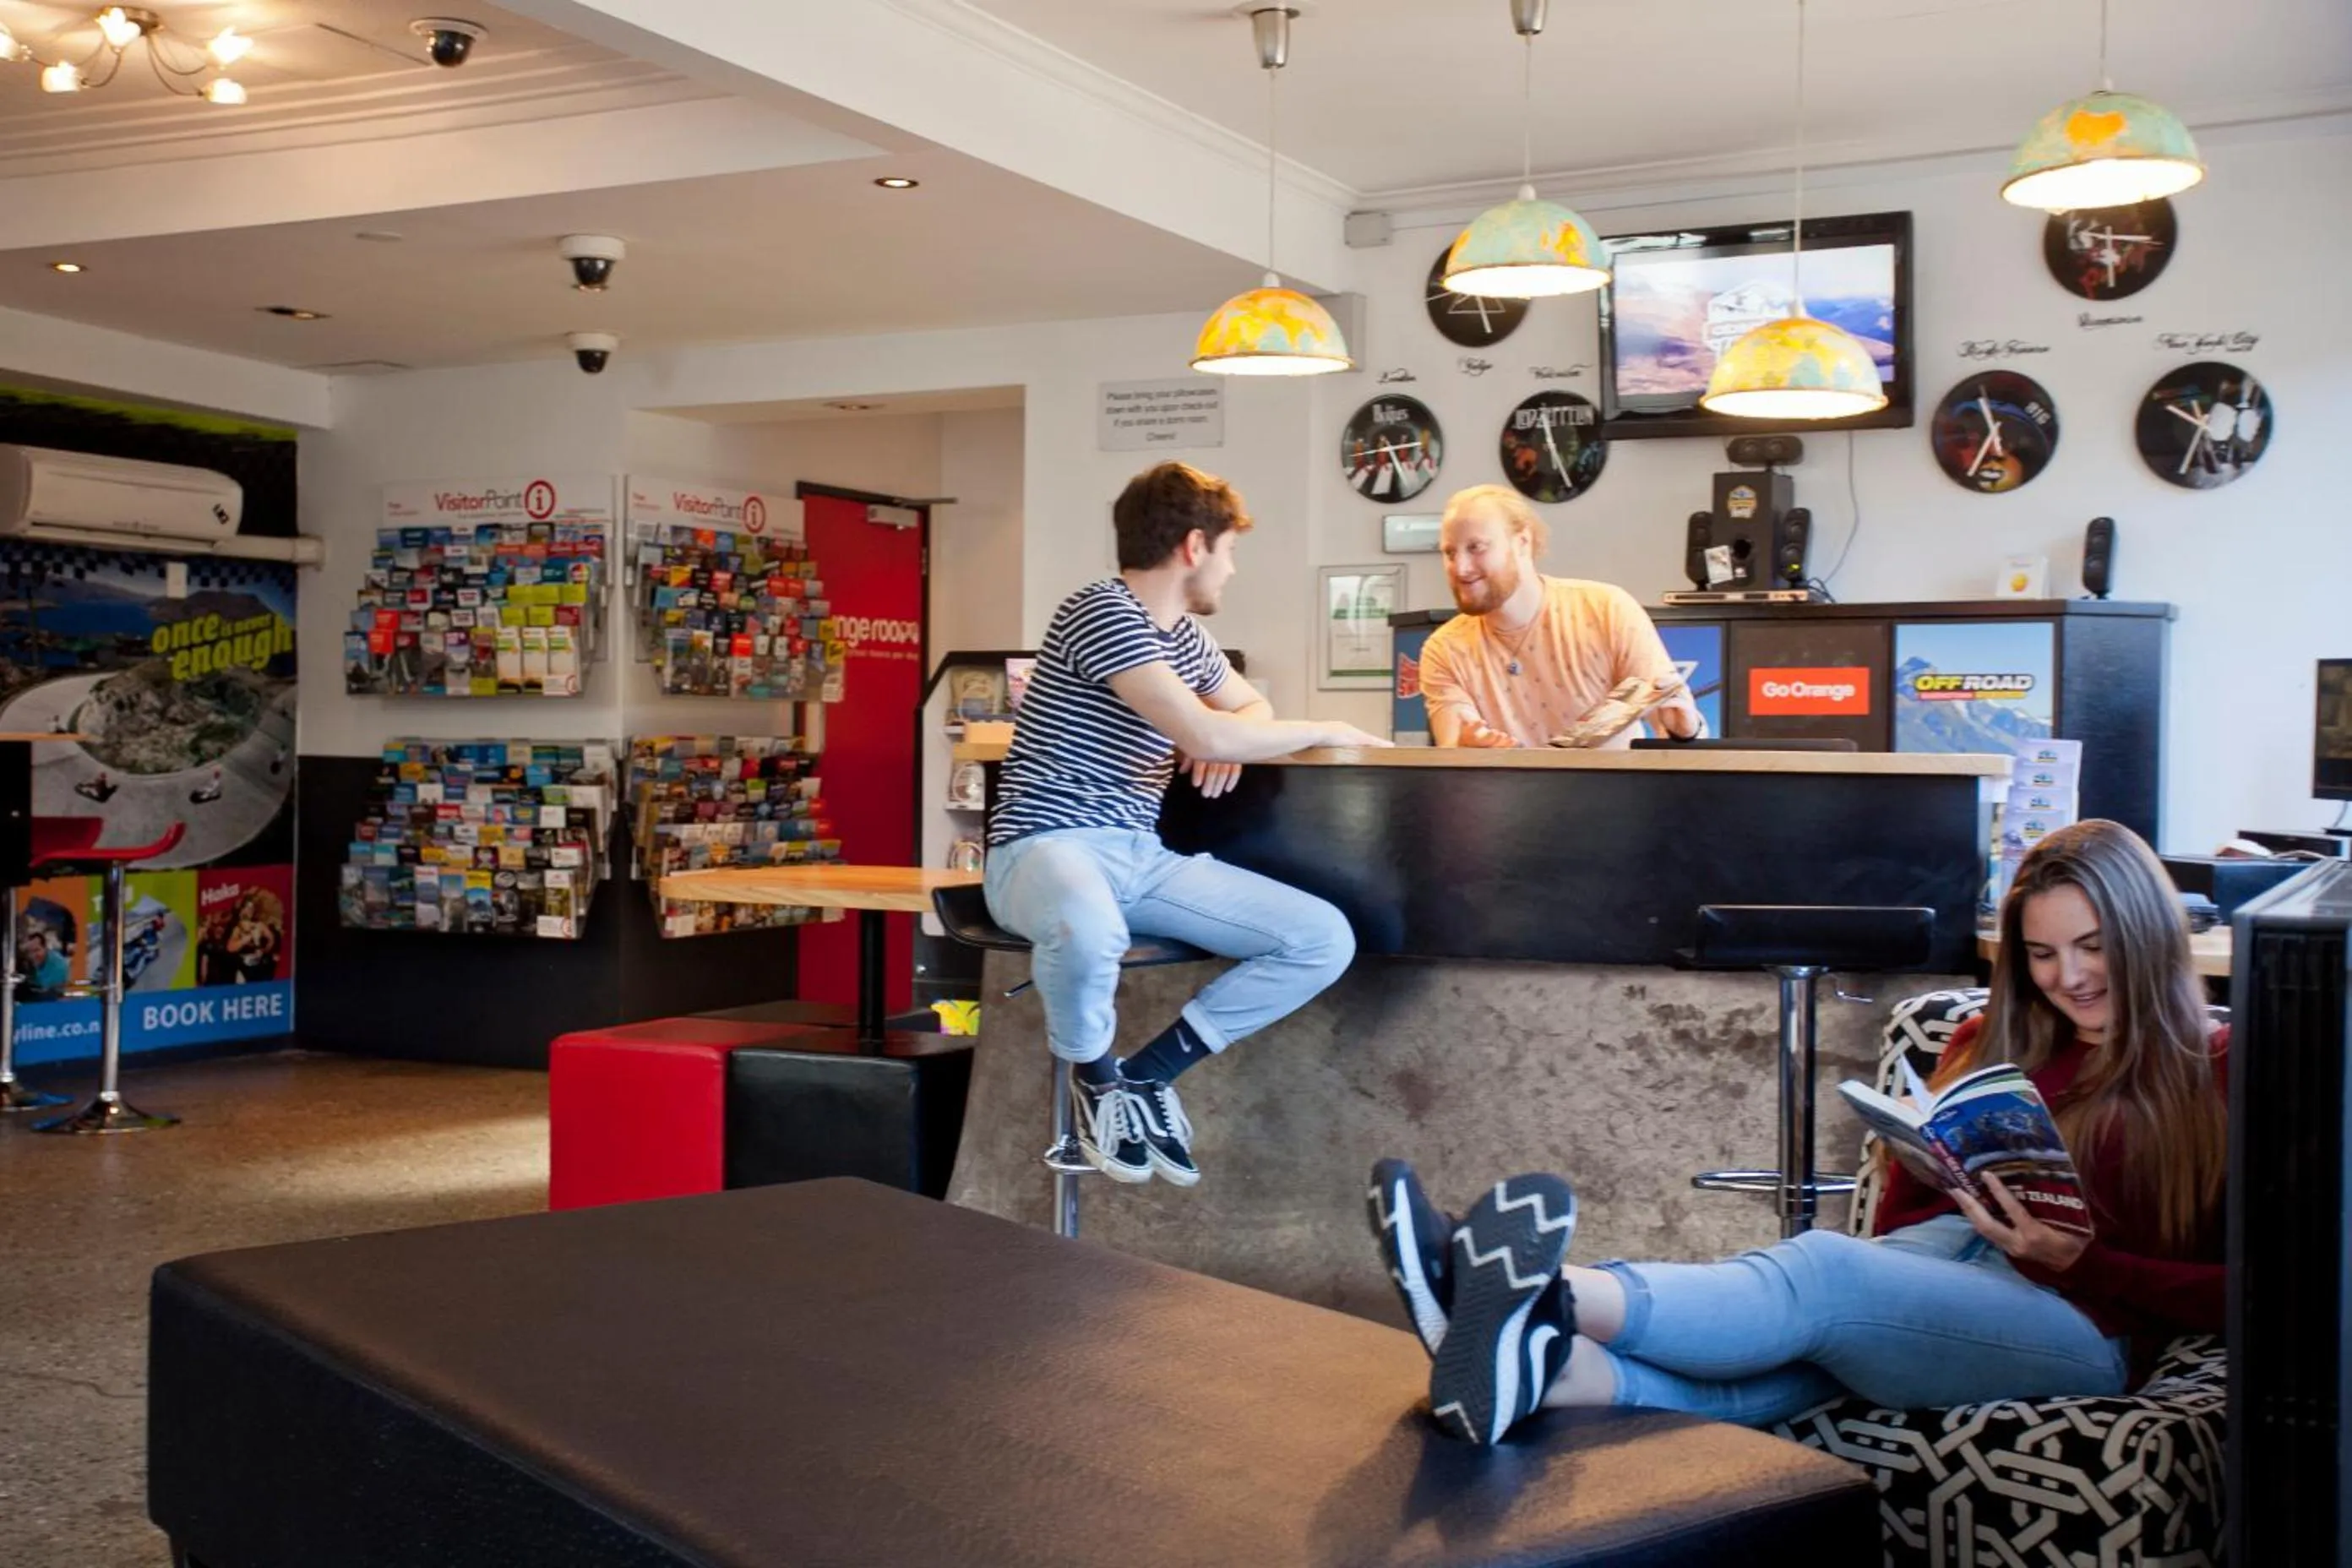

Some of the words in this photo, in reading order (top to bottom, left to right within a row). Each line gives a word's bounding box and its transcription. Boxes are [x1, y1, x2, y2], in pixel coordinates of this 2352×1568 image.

[433, 489, 523, 511] VisitorPoint
[672, 492, 742, 519] VisitorPoint
[151, 612, 220, 654] once
[171, 612, 293, 681] enough
[1761, 682, 1788, 699] Go
[1789, 682, 1855, 701] Orange
[1914, 675, 1964, 692] OFF
[1963, 675, 2035, 692] ROAD
[143, 1000, 215, 1031] BOOK
[223, 994, 283, 1022] HERE
[2026, 1190, 2085, 1210] ZEALAND
